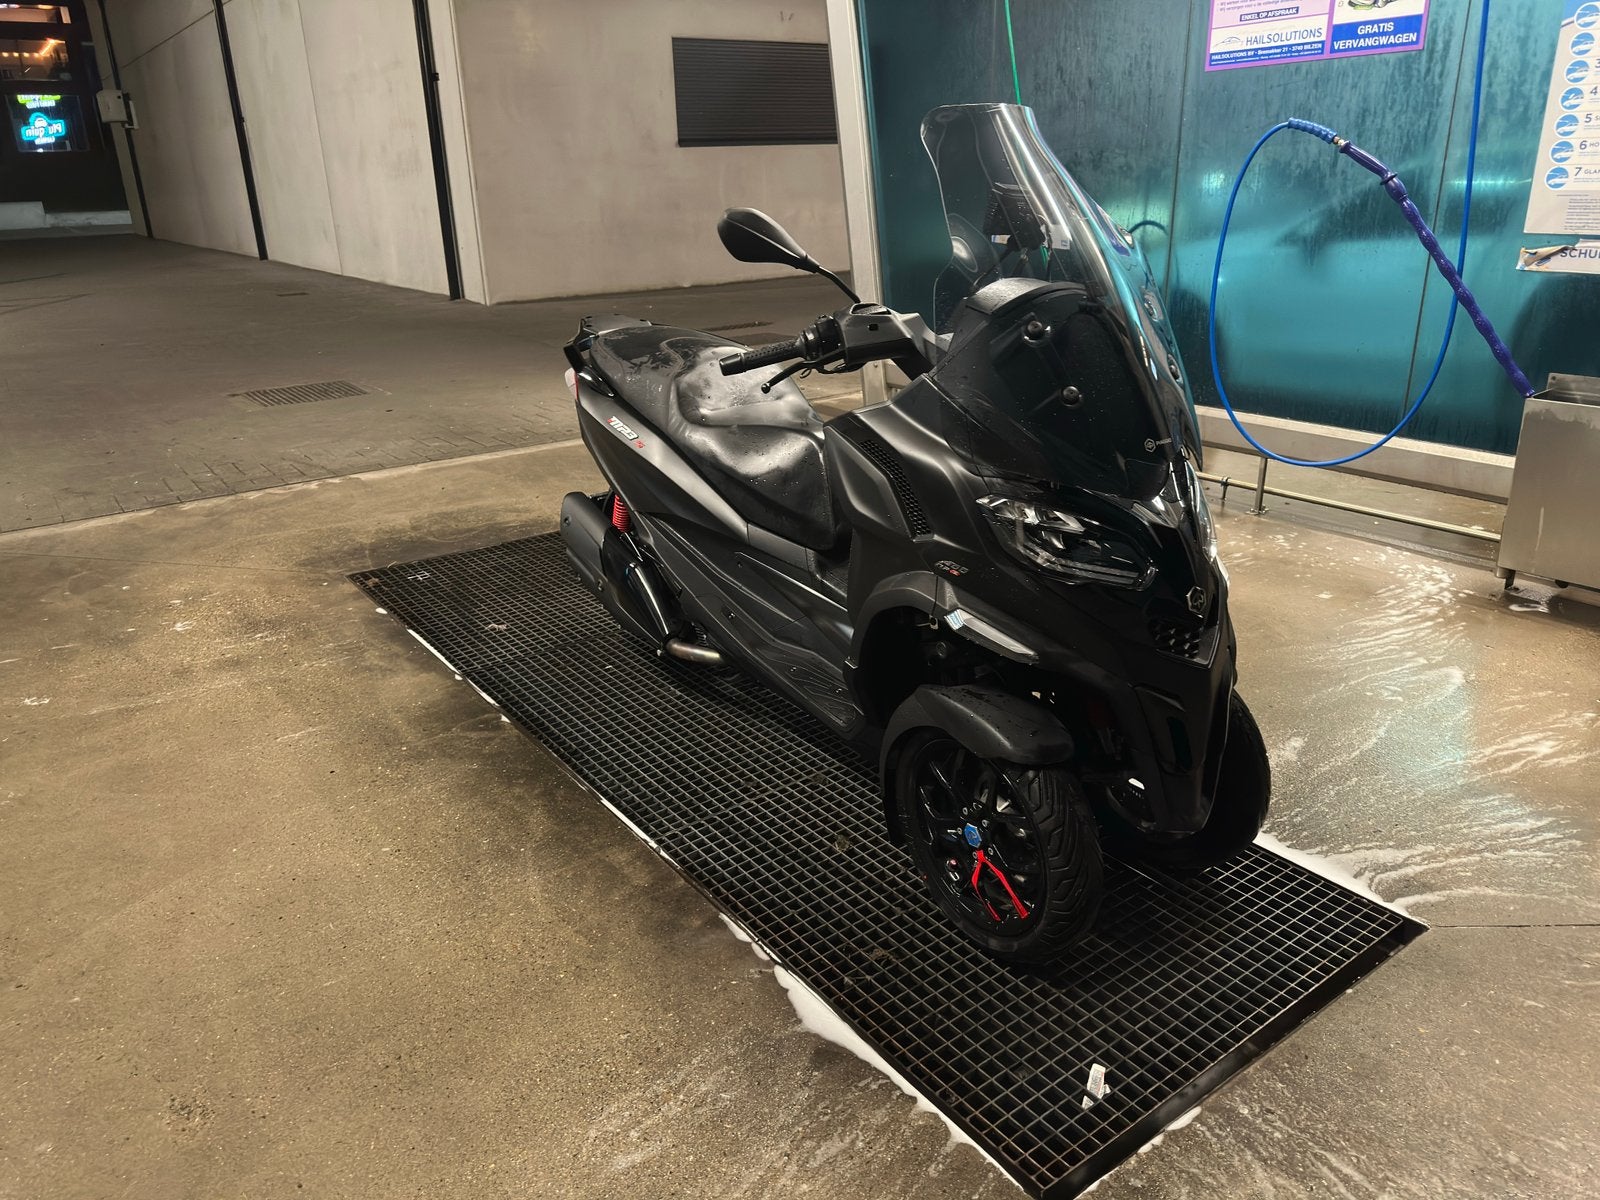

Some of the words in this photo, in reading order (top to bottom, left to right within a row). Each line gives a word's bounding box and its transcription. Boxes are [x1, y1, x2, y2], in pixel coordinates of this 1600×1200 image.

[1241, 13, 1259, 21] ENKEL
[1267, 8, 1297, 18] AFSPRAAK
[1357, 22, 1394, 35] GRATIS
[1245, 28, 1323, 46] HAILSOLUTIONS
[1333, 32, 1418, 50] VERVANGWAGEN
[1211, 51, 1247, 60] HAILSOLUTIONS
[1589, 86, 1598, 96] 4
[1584, 113, 1593, 123] 5
[1579, 140, 1588, 150] 6
[1574, 167, 1582, 177] 7
